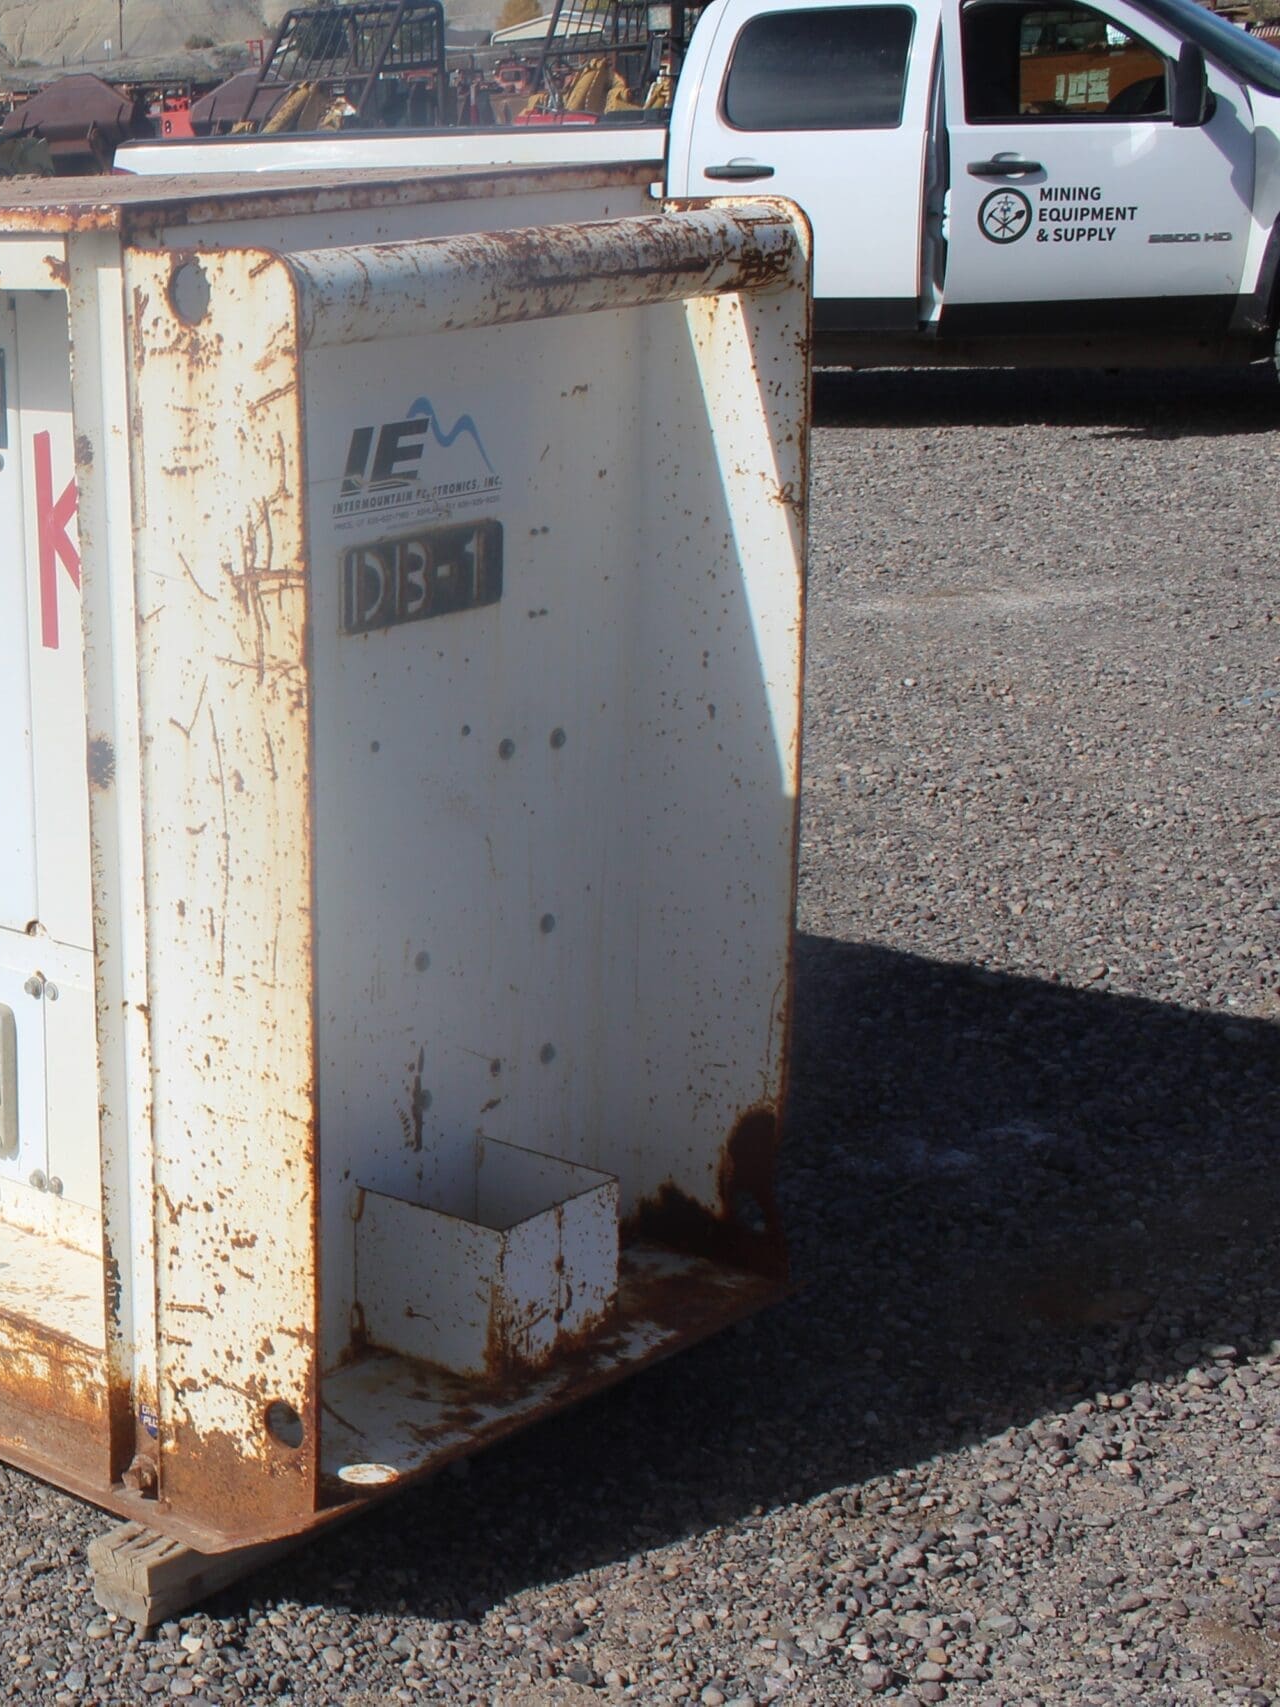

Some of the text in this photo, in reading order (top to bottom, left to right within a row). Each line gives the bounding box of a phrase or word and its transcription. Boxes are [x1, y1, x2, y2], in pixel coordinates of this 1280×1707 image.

[1039, 187, 1102, 201] MINING
[1038, 206, 1138, 222] EQUIPMENT
[1036, 227, 1117, 242] & SUPPLY
[1204, 232, 1233, 242] HD
[332, 490, 414, 515] INTERMOUNTAIN
[484, 475, 503, 488] INC.
[33, 430, 80, 650] K
[351, 529, 484, 626] DB-1
